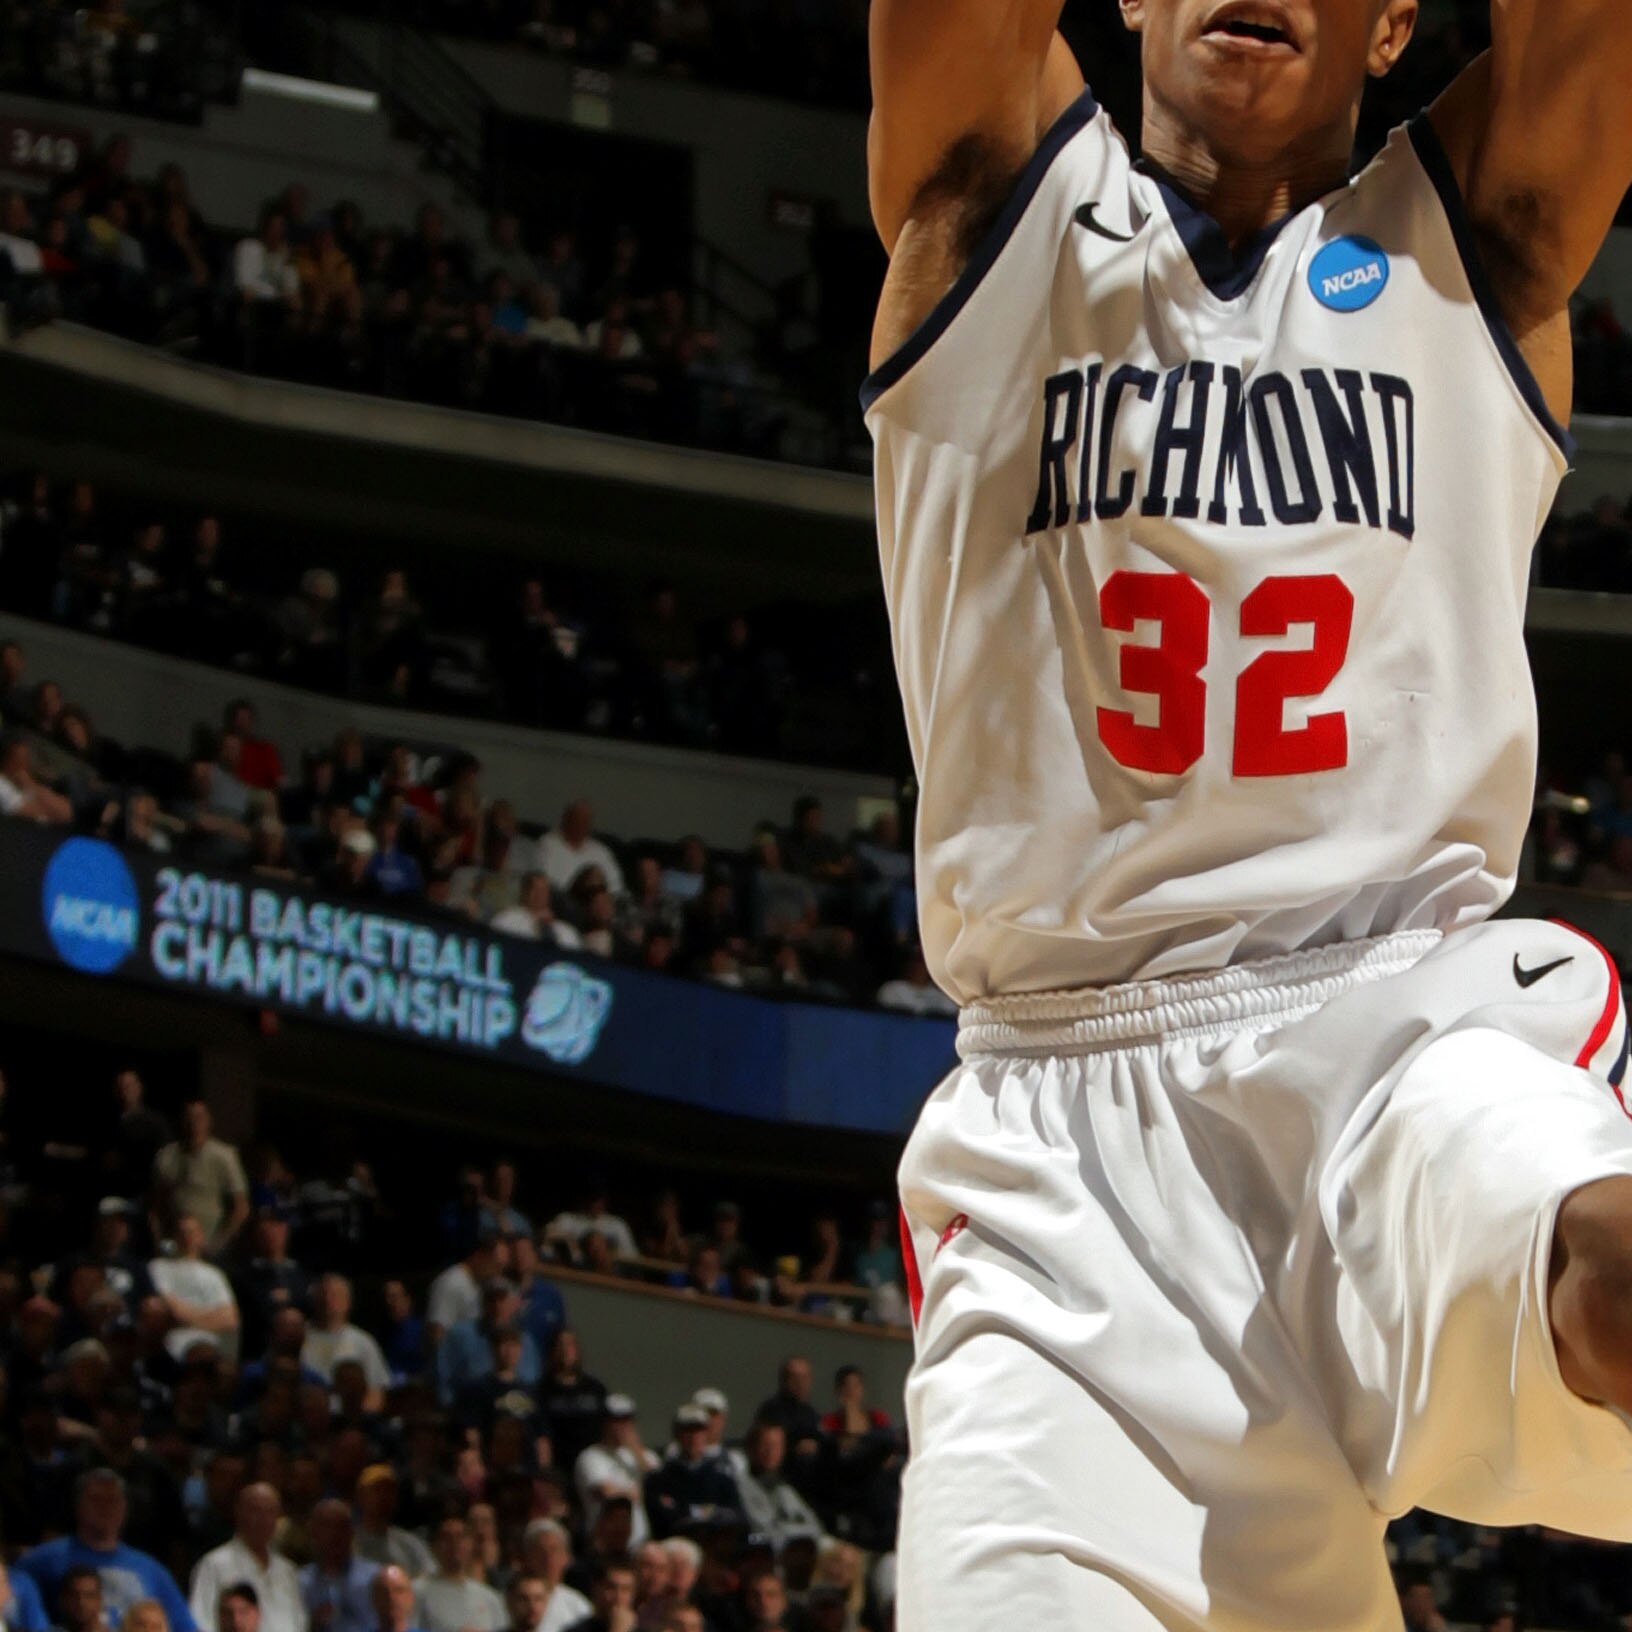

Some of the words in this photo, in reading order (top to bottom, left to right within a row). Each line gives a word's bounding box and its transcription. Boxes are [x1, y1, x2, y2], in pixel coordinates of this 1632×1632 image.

[1322, 262, 1381, 297] NCAA
[1025, 361, 1415, 542] RICHMOND
[1096, 569, 1355, 779] 32
[150, 918, 518, 1050] CHAMPIONSHIP
[154, 868, 243, 931] 2011
[248, 888, 513, 994] BASKETBALL
